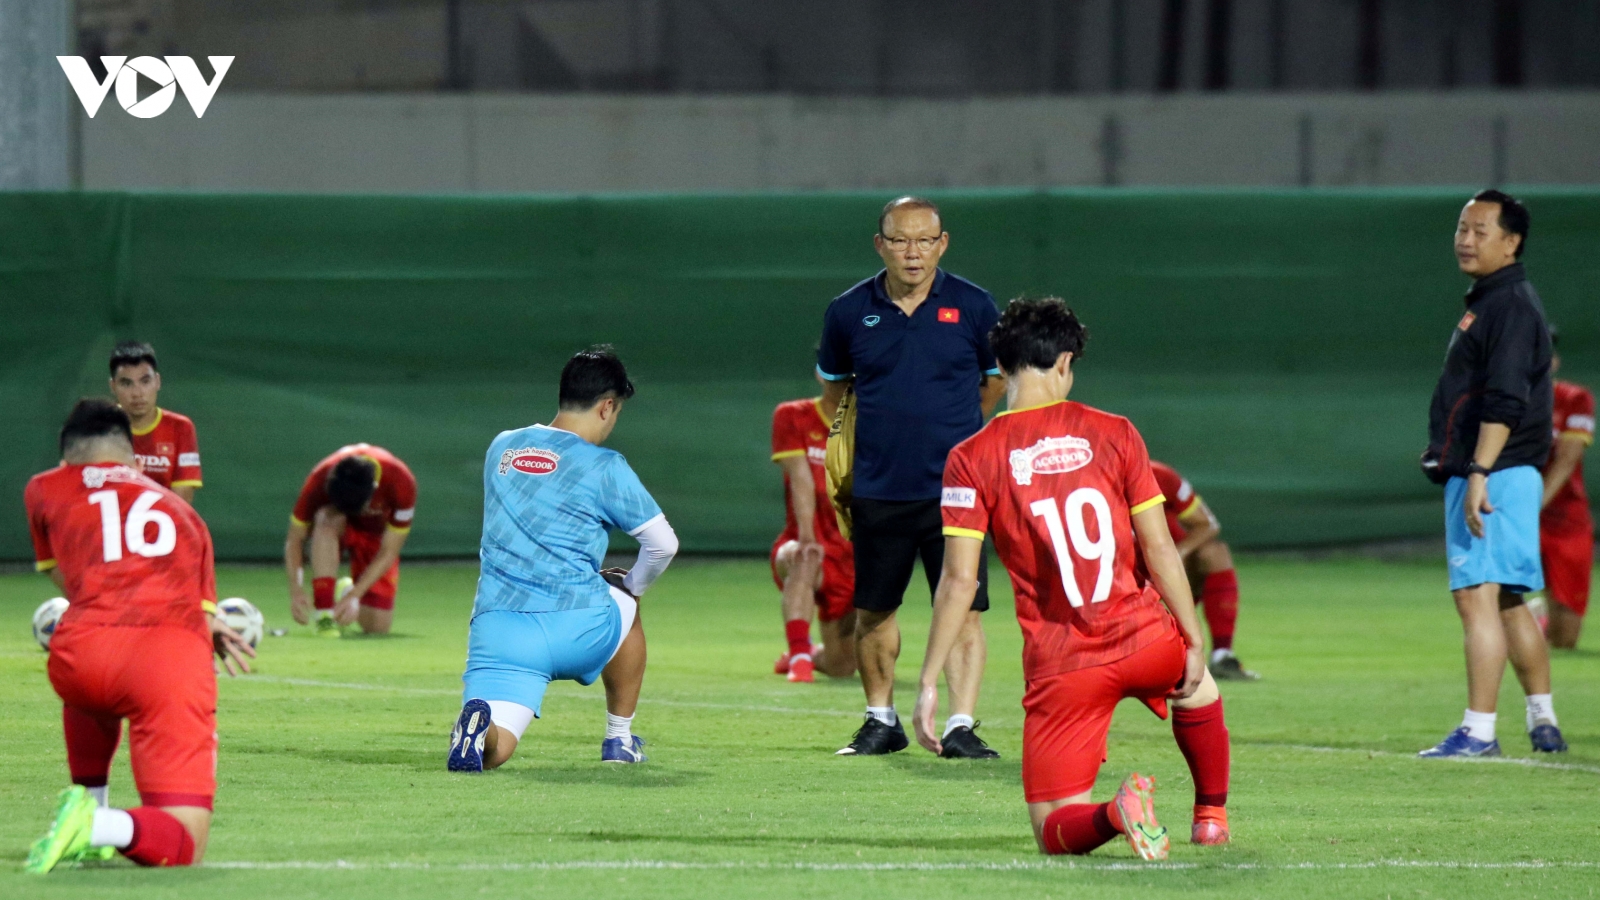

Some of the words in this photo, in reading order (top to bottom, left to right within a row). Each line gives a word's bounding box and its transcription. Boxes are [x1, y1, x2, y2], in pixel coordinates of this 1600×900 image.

[514, 448, 530, 456] Cook
[531, 448, 560, 461] happiness
[88, 490, 177, 563] 16
[1029, 487, 1116, 608] 19
